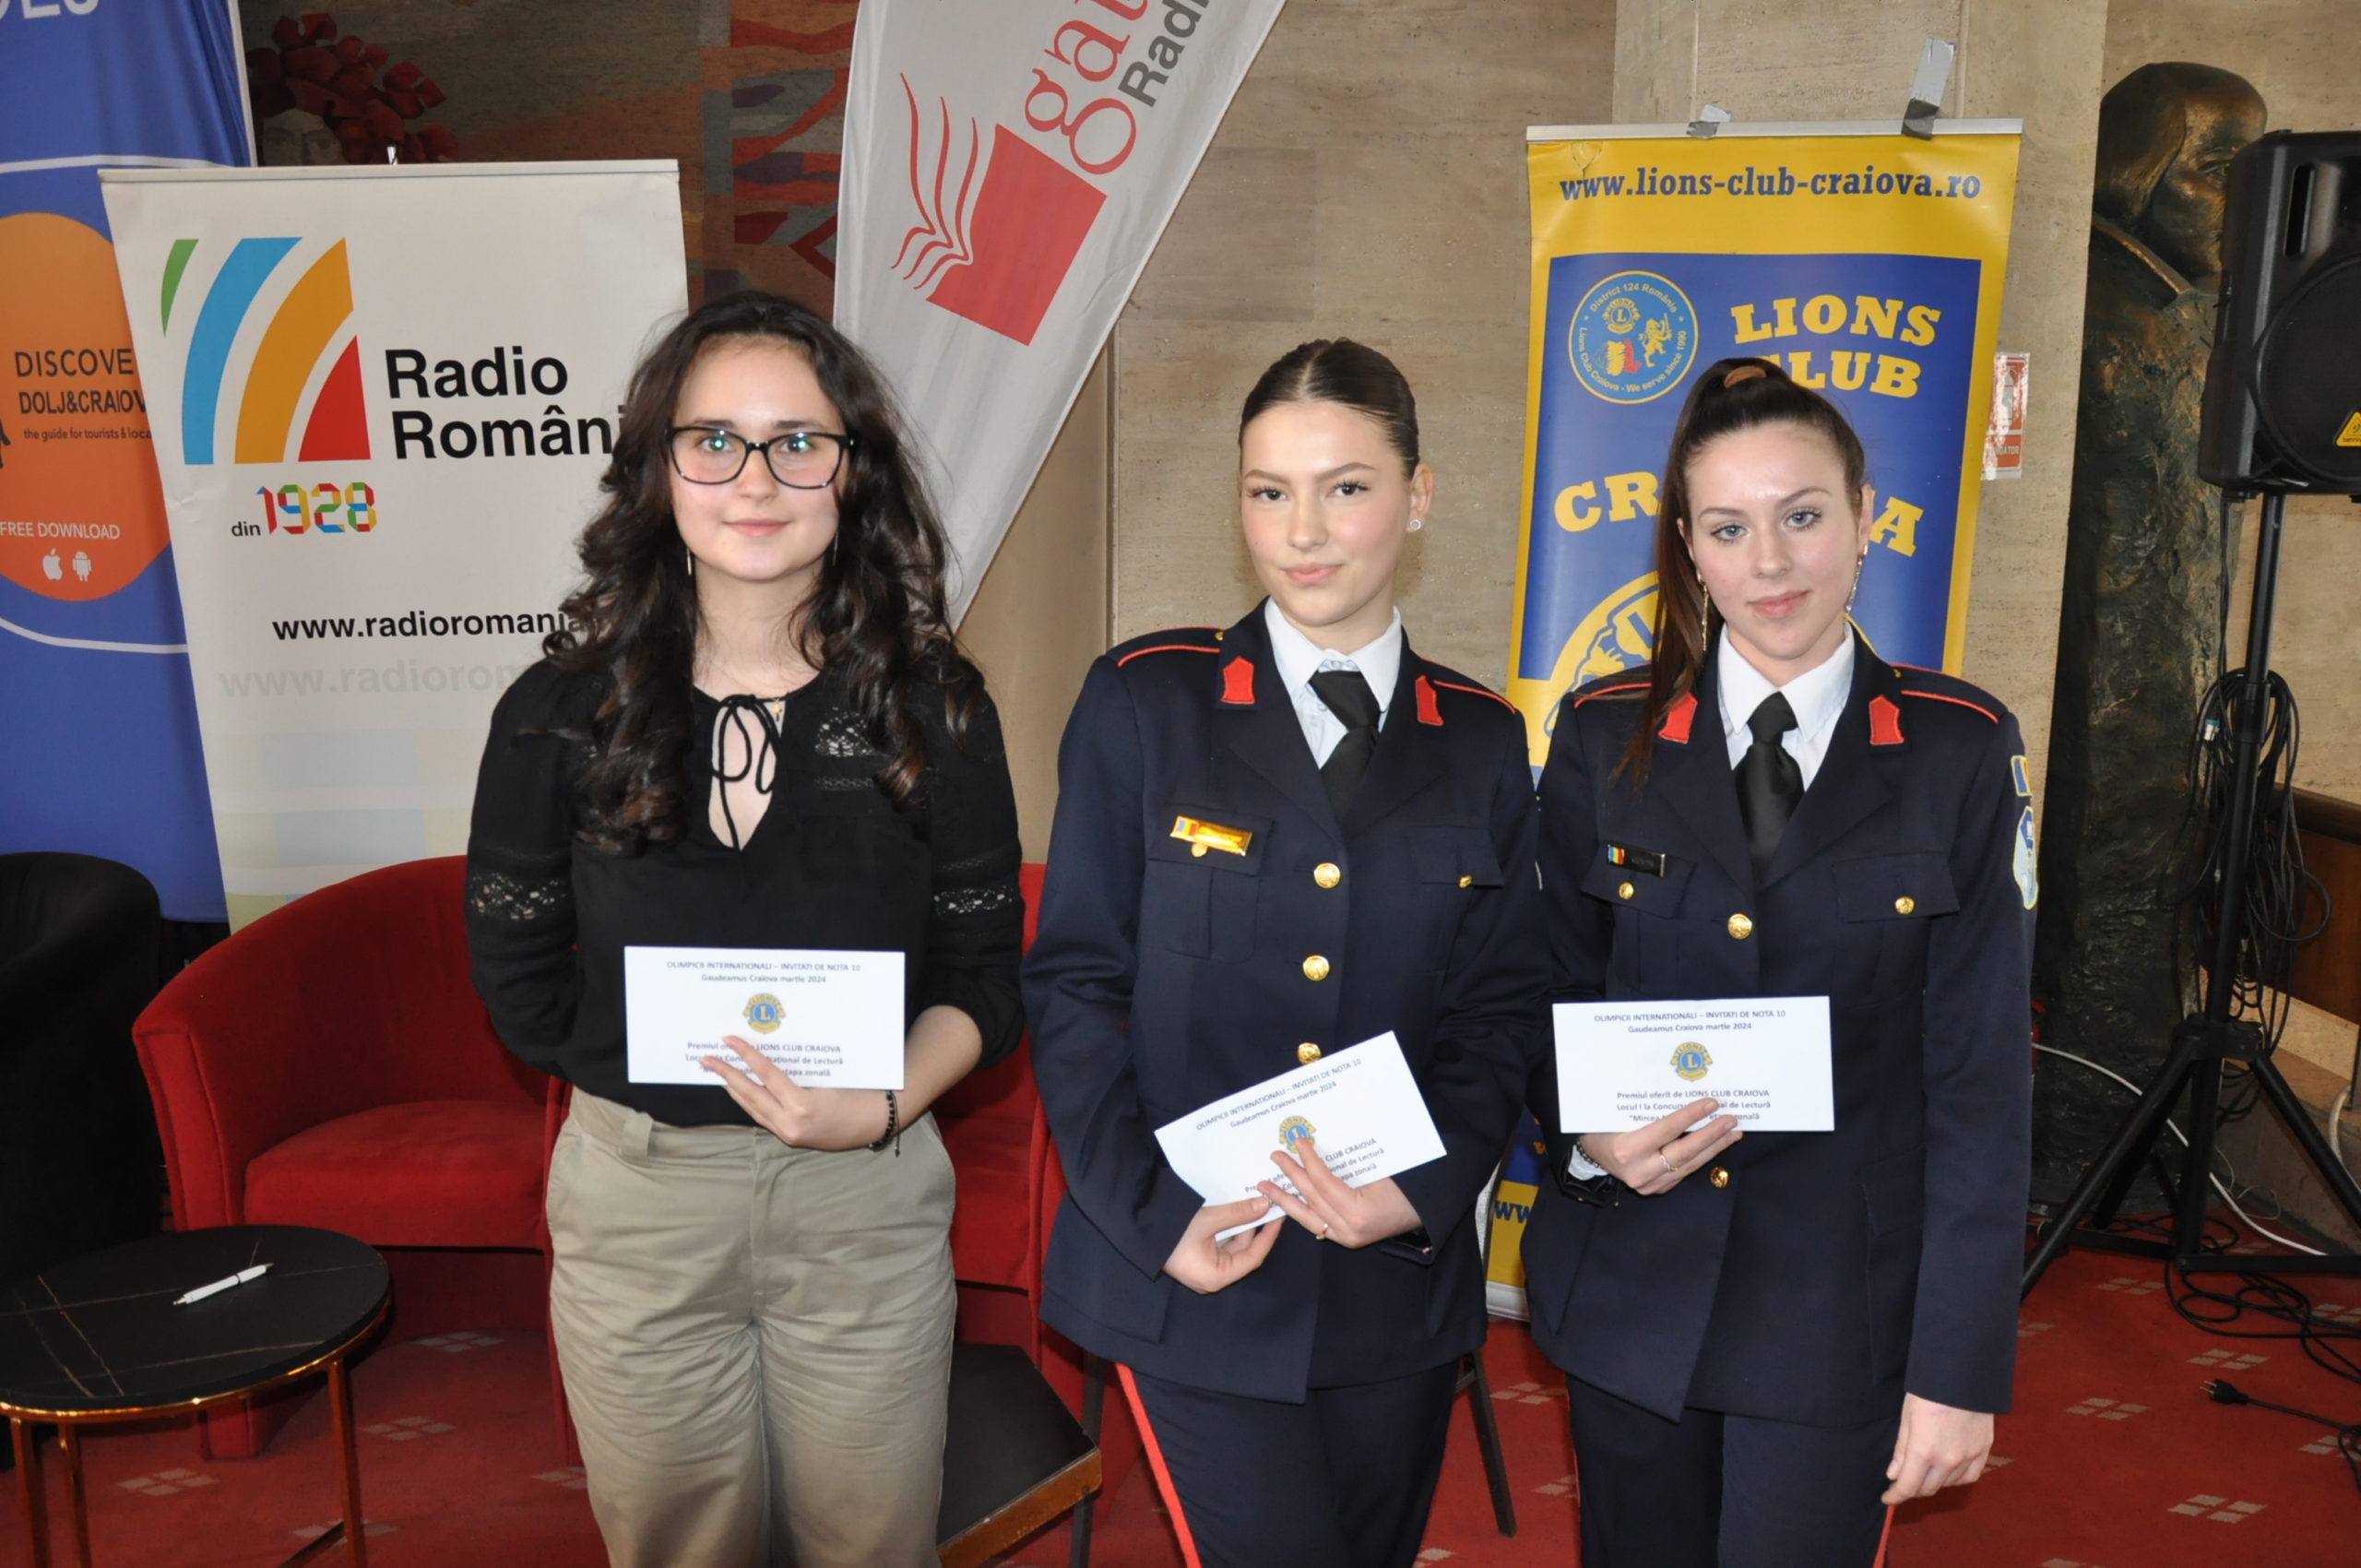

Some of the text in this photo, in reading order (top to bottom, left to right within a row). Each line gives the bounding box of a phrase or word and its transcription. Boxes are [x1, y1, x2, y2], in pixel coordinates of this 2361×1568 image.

[1560, 166, 1982, 200] www.lions-club-craiova.ro
[1590, 286, 1620, 312] District
[1623, 283, 1639, 291] 124
[1730, 294, 1941, 346] LIONS
[15, 349, 134, 377] DISCOVE
[386, 346, 568, 398] Radio
[1591, 371, 1620, 391] Craiova
[1755, 350, 1922, 398] LUB
[24, 429, 39, 439] the
[42, 428, 67, 442] guide
[69, 428, 83, 439] for
[85, 428, 119, 439] tourists
[231, 482, 376, 537] din 1928
[0, 521, 120, 540] FREE DOWNLOAD
[701, 974, 748, 982] Gaudeamus
[779, 975, 805, 983] martie
[807, 975, 826, 983] 2024
[1594, 1014, 1631, 1022] OLIMPICII
[1752, 1010, 1774, 1018] NOTA
[1628, 1025, 1673, 1033] Gaudeamus
[1705, 1022, 1731, 1030] martie
[687, 1041, 718, 1050] Premiul
[757, 1043, 780, 1051] LIONS
[805, 1045, 841, 1053] CRAIOVA
[813, 1057, 843, 1065] Lectură
[1321, 1070, 1331, 1079] DE
[1332, 1063, 1351, 1075] NOTA
[1230, 1109, 1269, 1127] Gaudeamus
[1270, 1098, 1296, 1111] Craiova
[1320, 1081, 1336, 1092] 2024
[1649, 1090, 1671, 1099] oferit
[1685, 1089, 1709, 1098] LIONS
[1325, 1138, 1376, 1162] CLUB CRAIOVA
